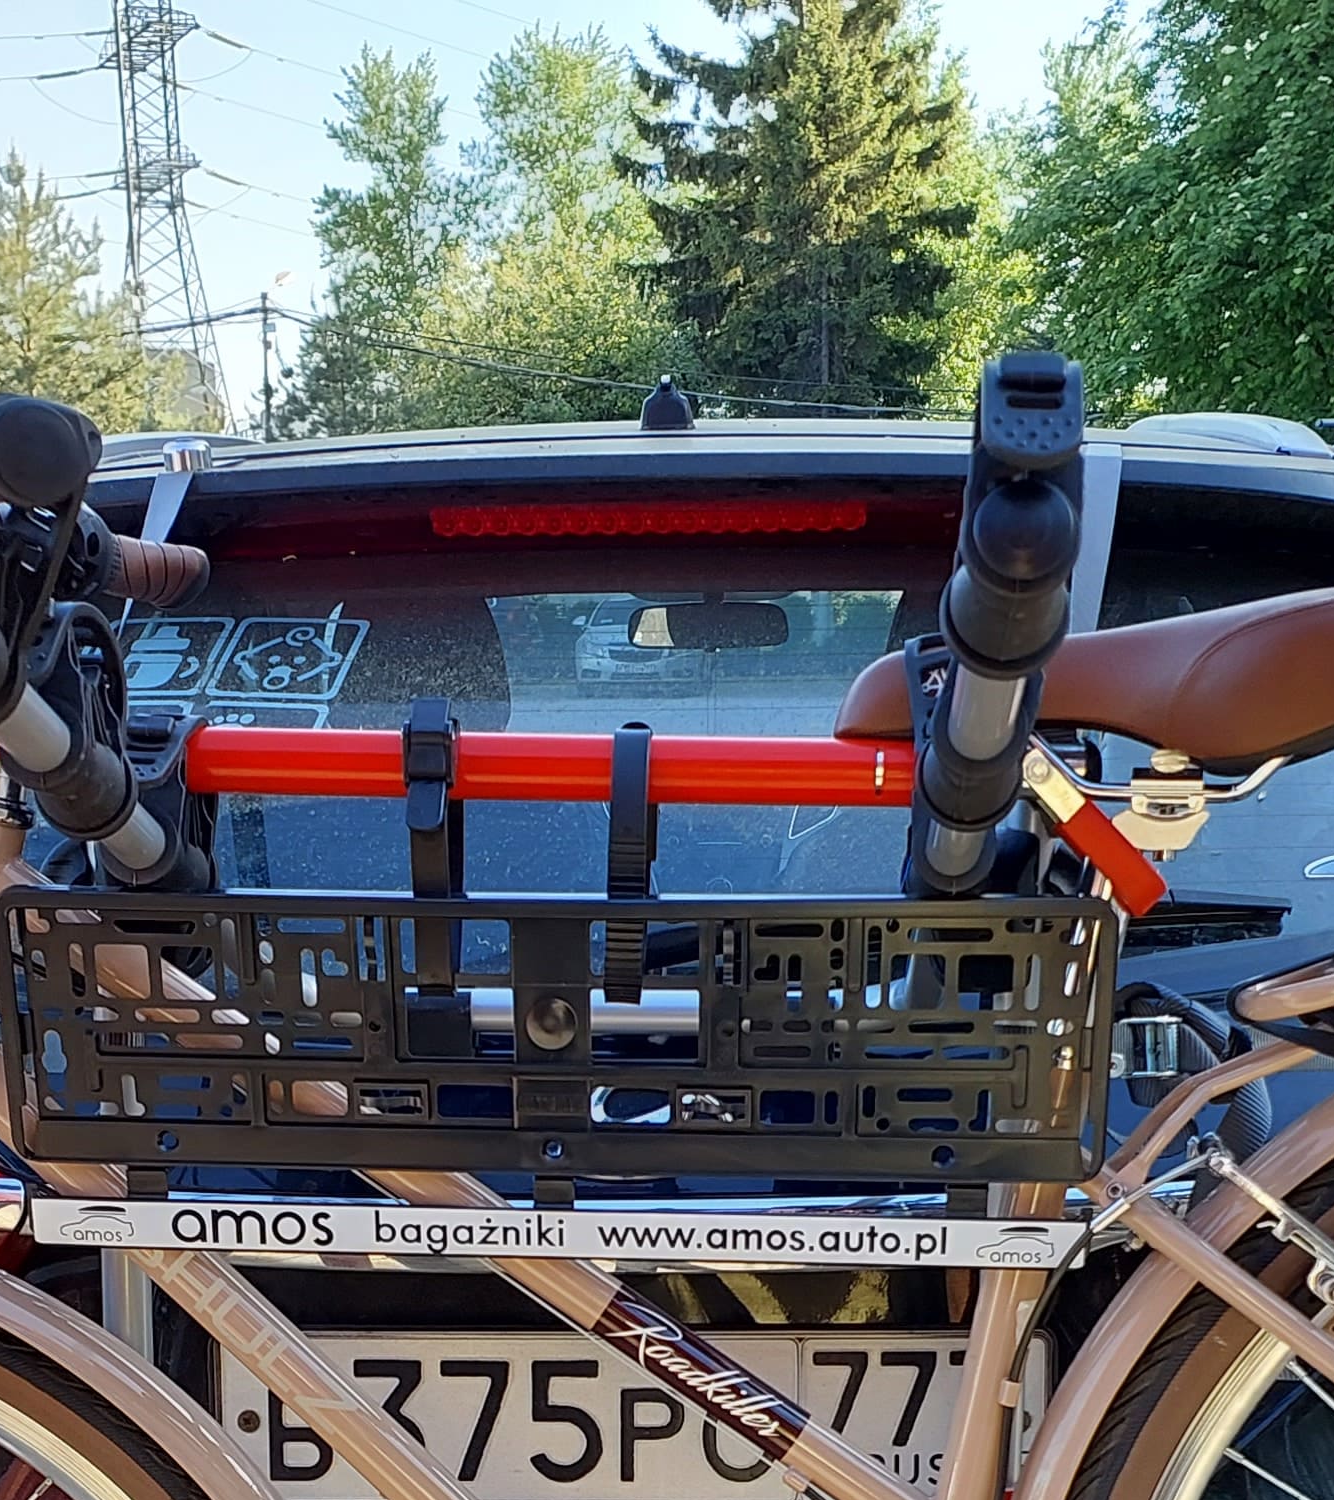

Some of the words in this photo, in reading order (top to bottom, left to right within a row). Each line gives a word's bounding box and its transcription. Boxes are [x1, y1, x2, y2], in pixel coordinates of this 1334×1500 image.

[72, 1228, 123, 1243] amos
[171, 1208, 335, 1247] amos
[373, 1209, 565, 1255] bagażniki
[597, 1224, 948, 1261] www.amos.auto.pl
[989, 1248, 1042, 1264] amos
[605, 1300, 784, 1438] Roadkiller
[812, 1350, 966, 1447] 77
[864, 1453, 945, 1487] US
